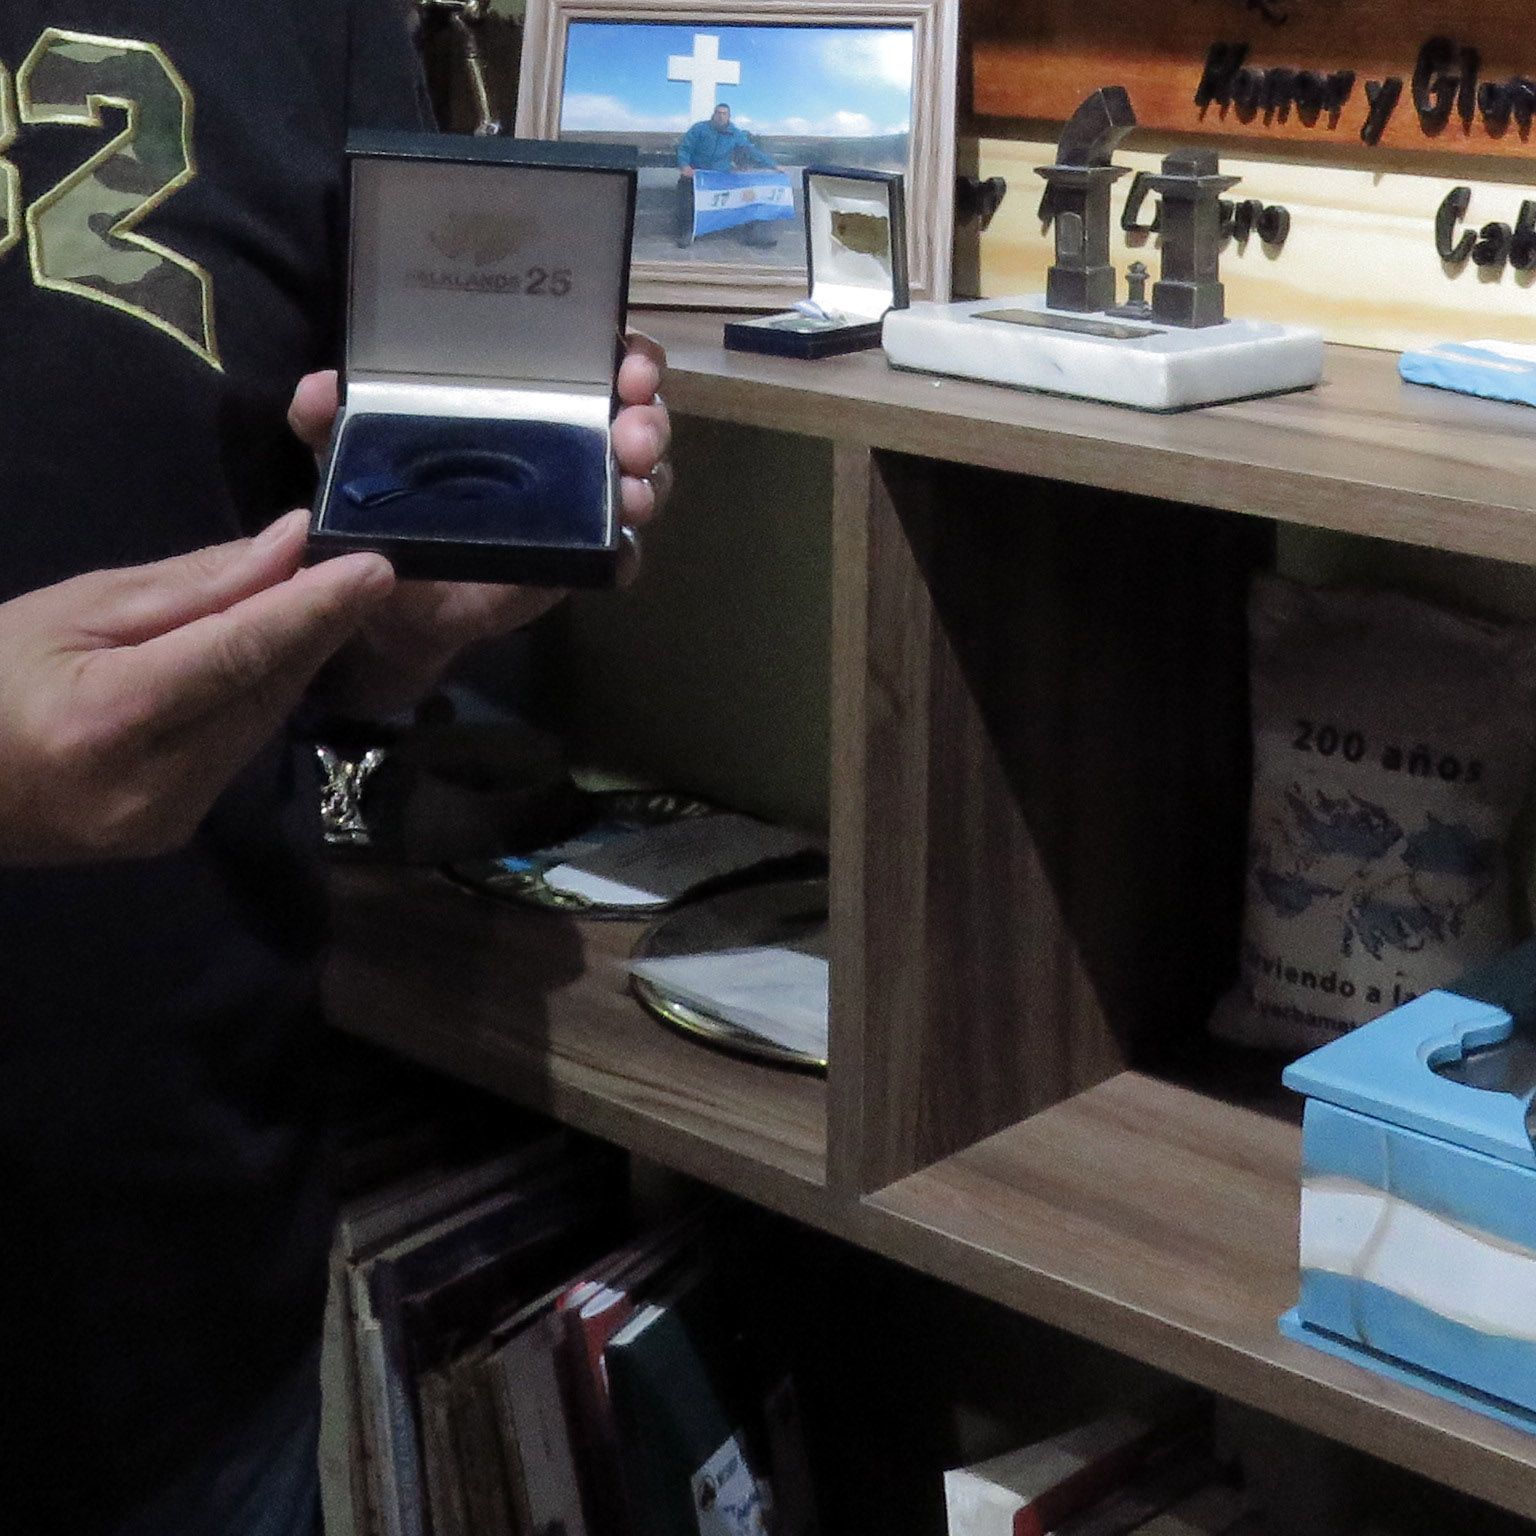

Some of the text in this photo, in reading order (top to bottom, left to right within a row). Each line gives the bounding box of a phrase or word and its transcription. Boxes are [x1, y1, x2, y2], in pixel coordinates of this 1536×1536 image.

[524, 266, 573, 297] 25
[1292, 719, 1484, 784] 200 años
